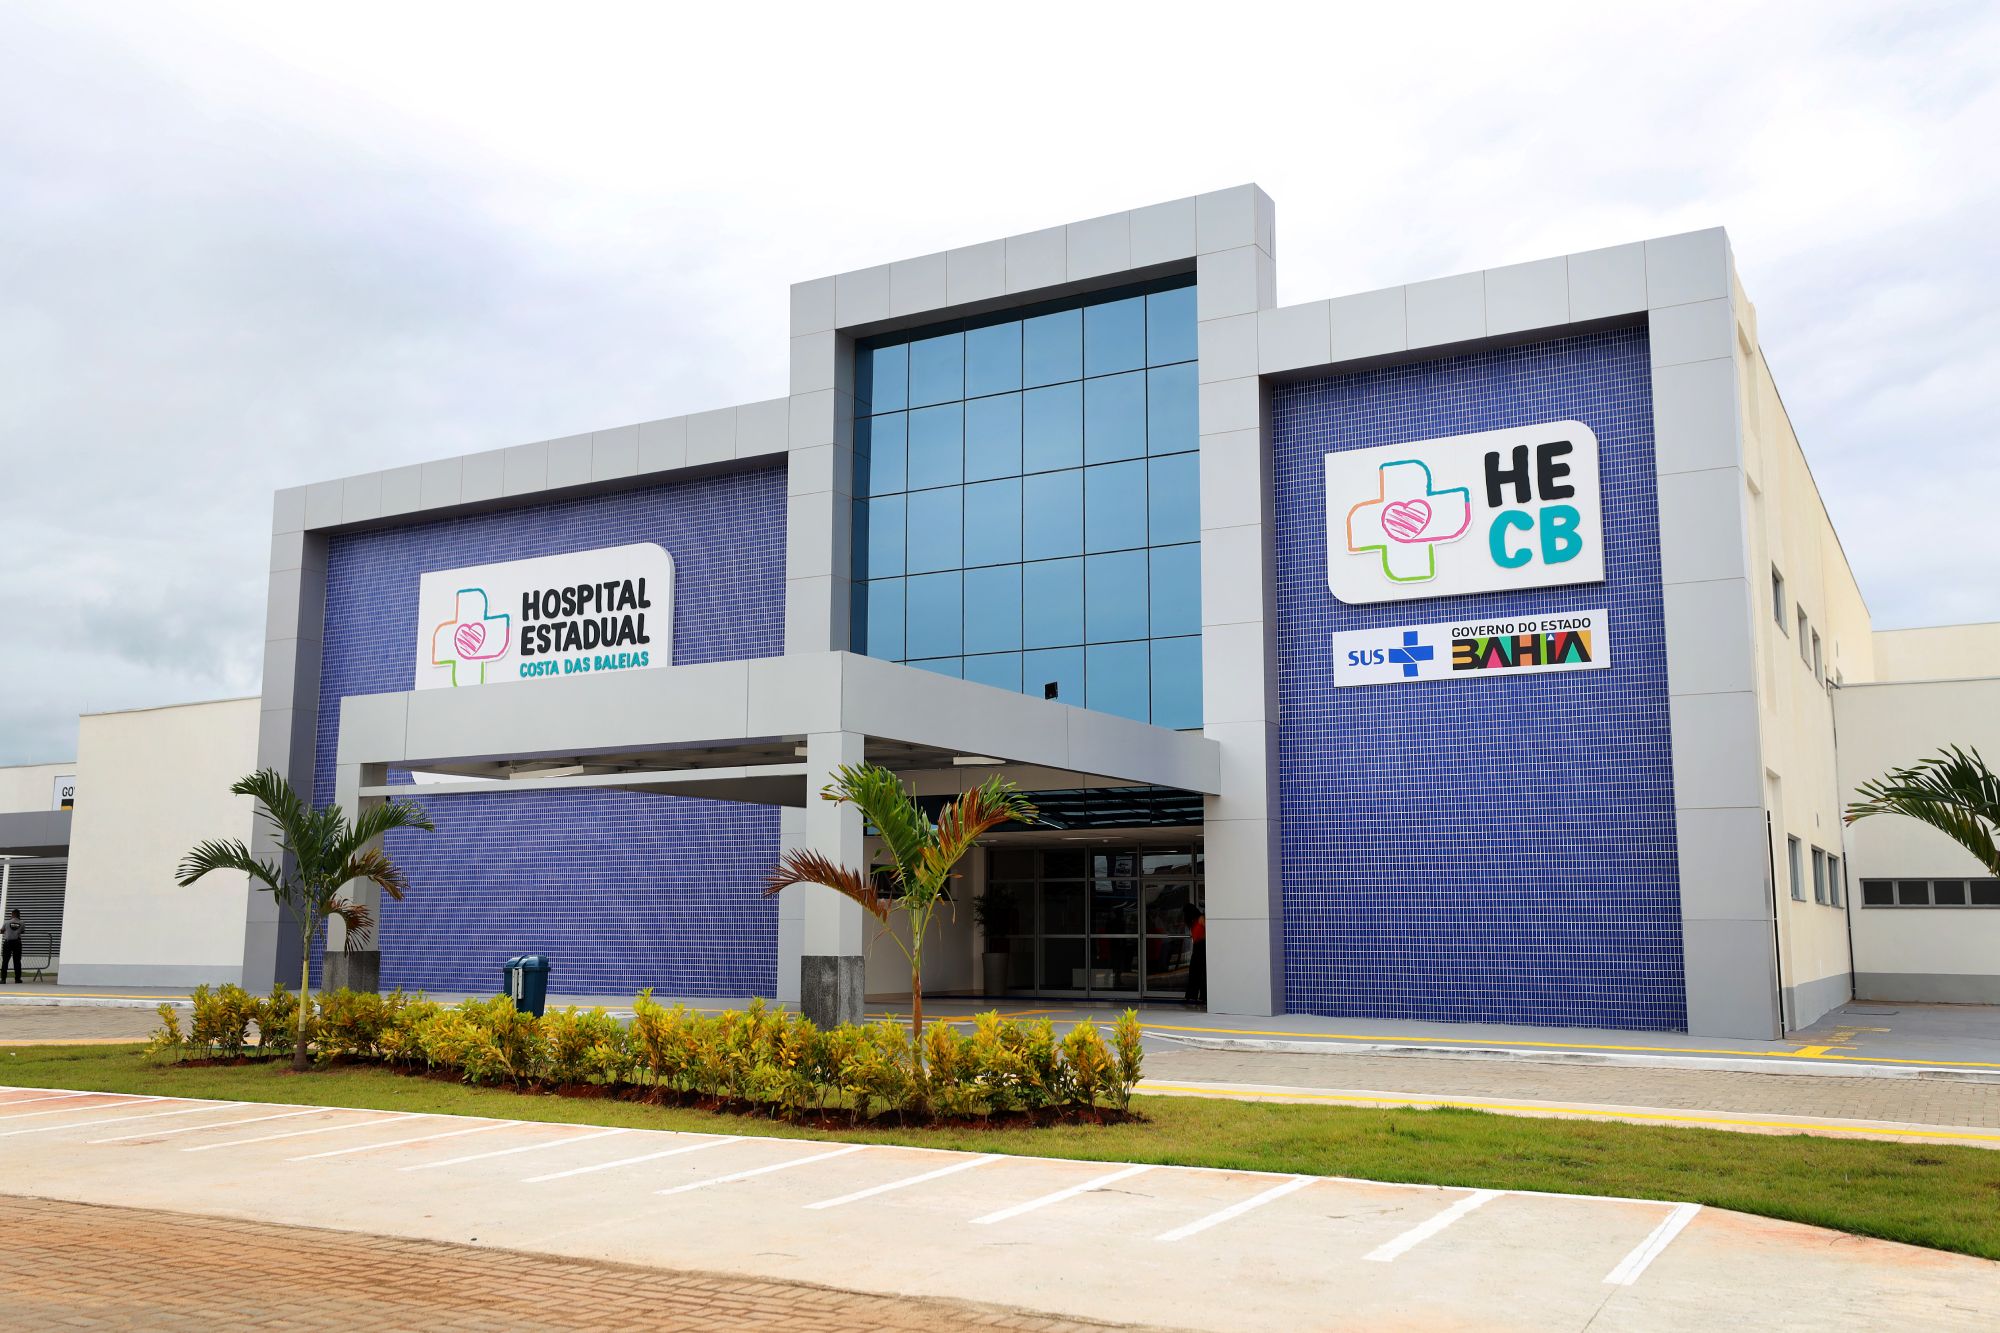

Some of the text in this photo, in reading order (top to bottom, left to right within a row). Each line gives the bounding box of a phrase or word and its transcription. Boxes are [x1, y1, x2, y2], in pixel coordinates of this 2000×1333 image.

[1484, 440, 1575, 508] HE
[1488, 504, 1583, 569] CB
[522, 577, 651, 622] HOSPITAL
[520, 613, 651, 656] ESTADUAL
[1451, 617, 1592, 638] GOVERNO DO ESTADO
[519, 650, 650, 678] COSTA DAS BALEIAS
[1347, 648, 1385, 667] SUS
[1451, 629, 1592, 671] BAHIA
[62, 786, 75, 797] GO
